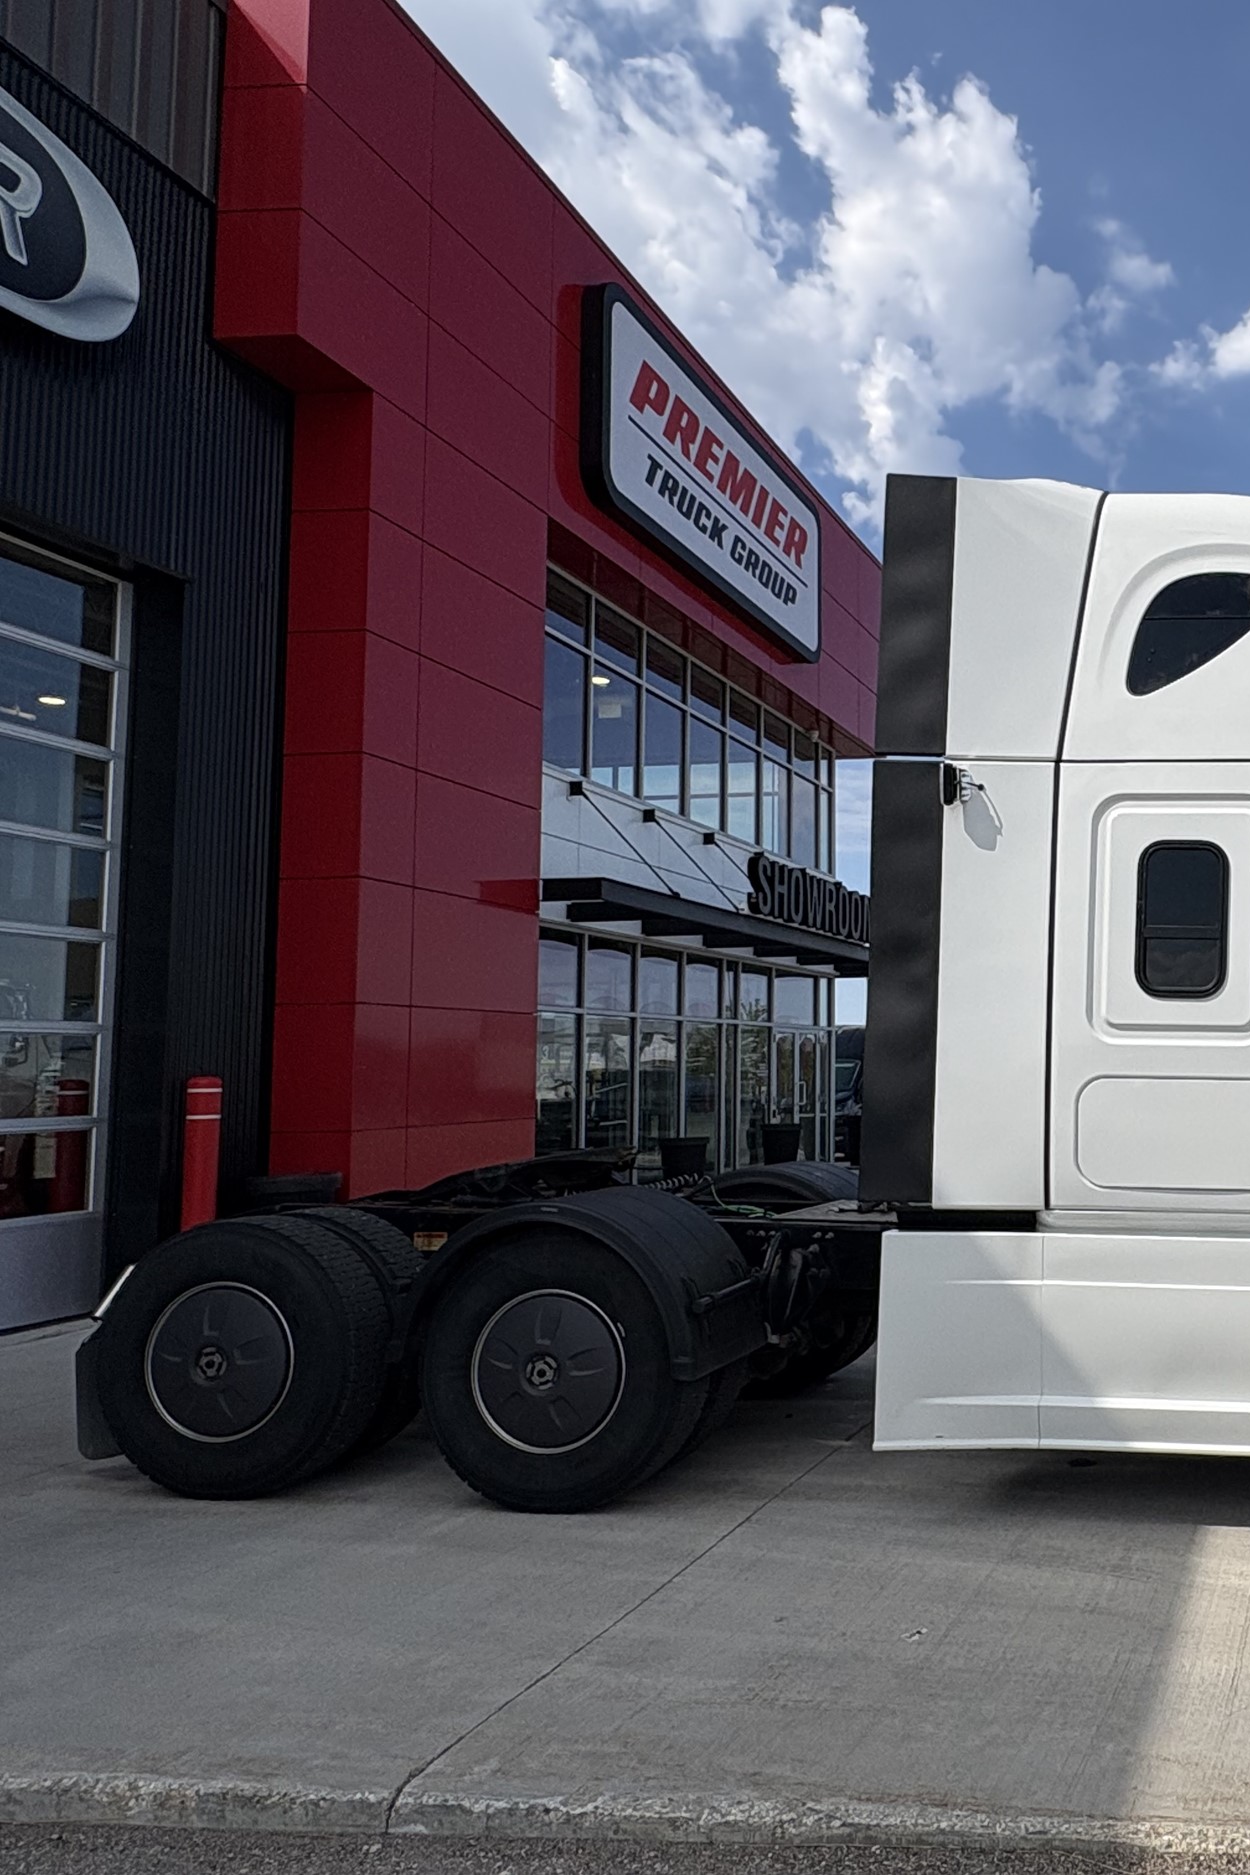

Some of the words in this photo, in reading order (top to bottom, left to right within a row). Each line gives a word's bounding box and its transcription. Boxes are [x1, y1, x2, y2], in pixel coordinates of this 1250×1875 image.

[629, 359, 808, 570] PREMIER
[645, 453, 728, 550] TRUCK
[729, 533, 798, 607] GROUP
